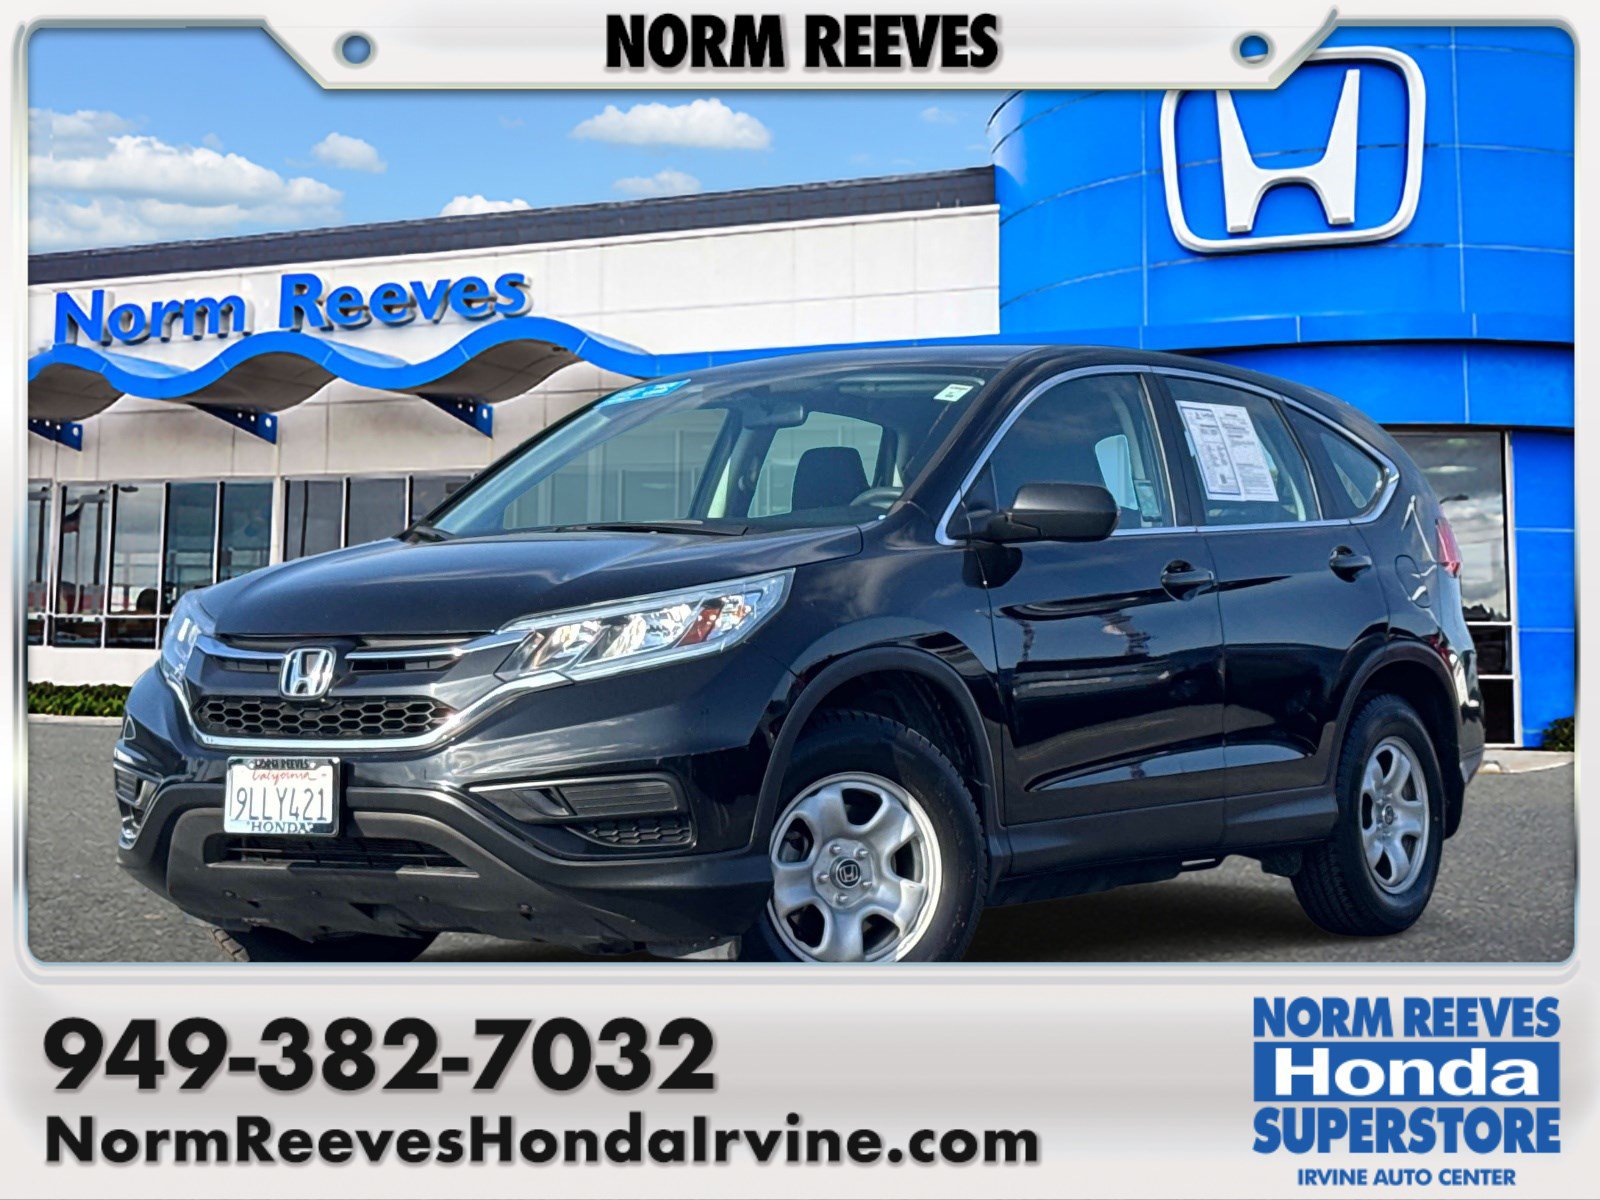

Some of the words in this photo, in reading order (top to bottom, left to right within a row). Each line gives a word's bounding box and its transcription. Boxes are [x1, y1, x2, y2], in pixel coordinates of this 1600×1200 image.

[54, 289, 248, 344] Norm
[279, 272, 528, 329] Reeves
[252, 769, 316, 785] California
[236, 787, 327, 821] 9LLY421
[251, 821, 311, 833] HONDA
